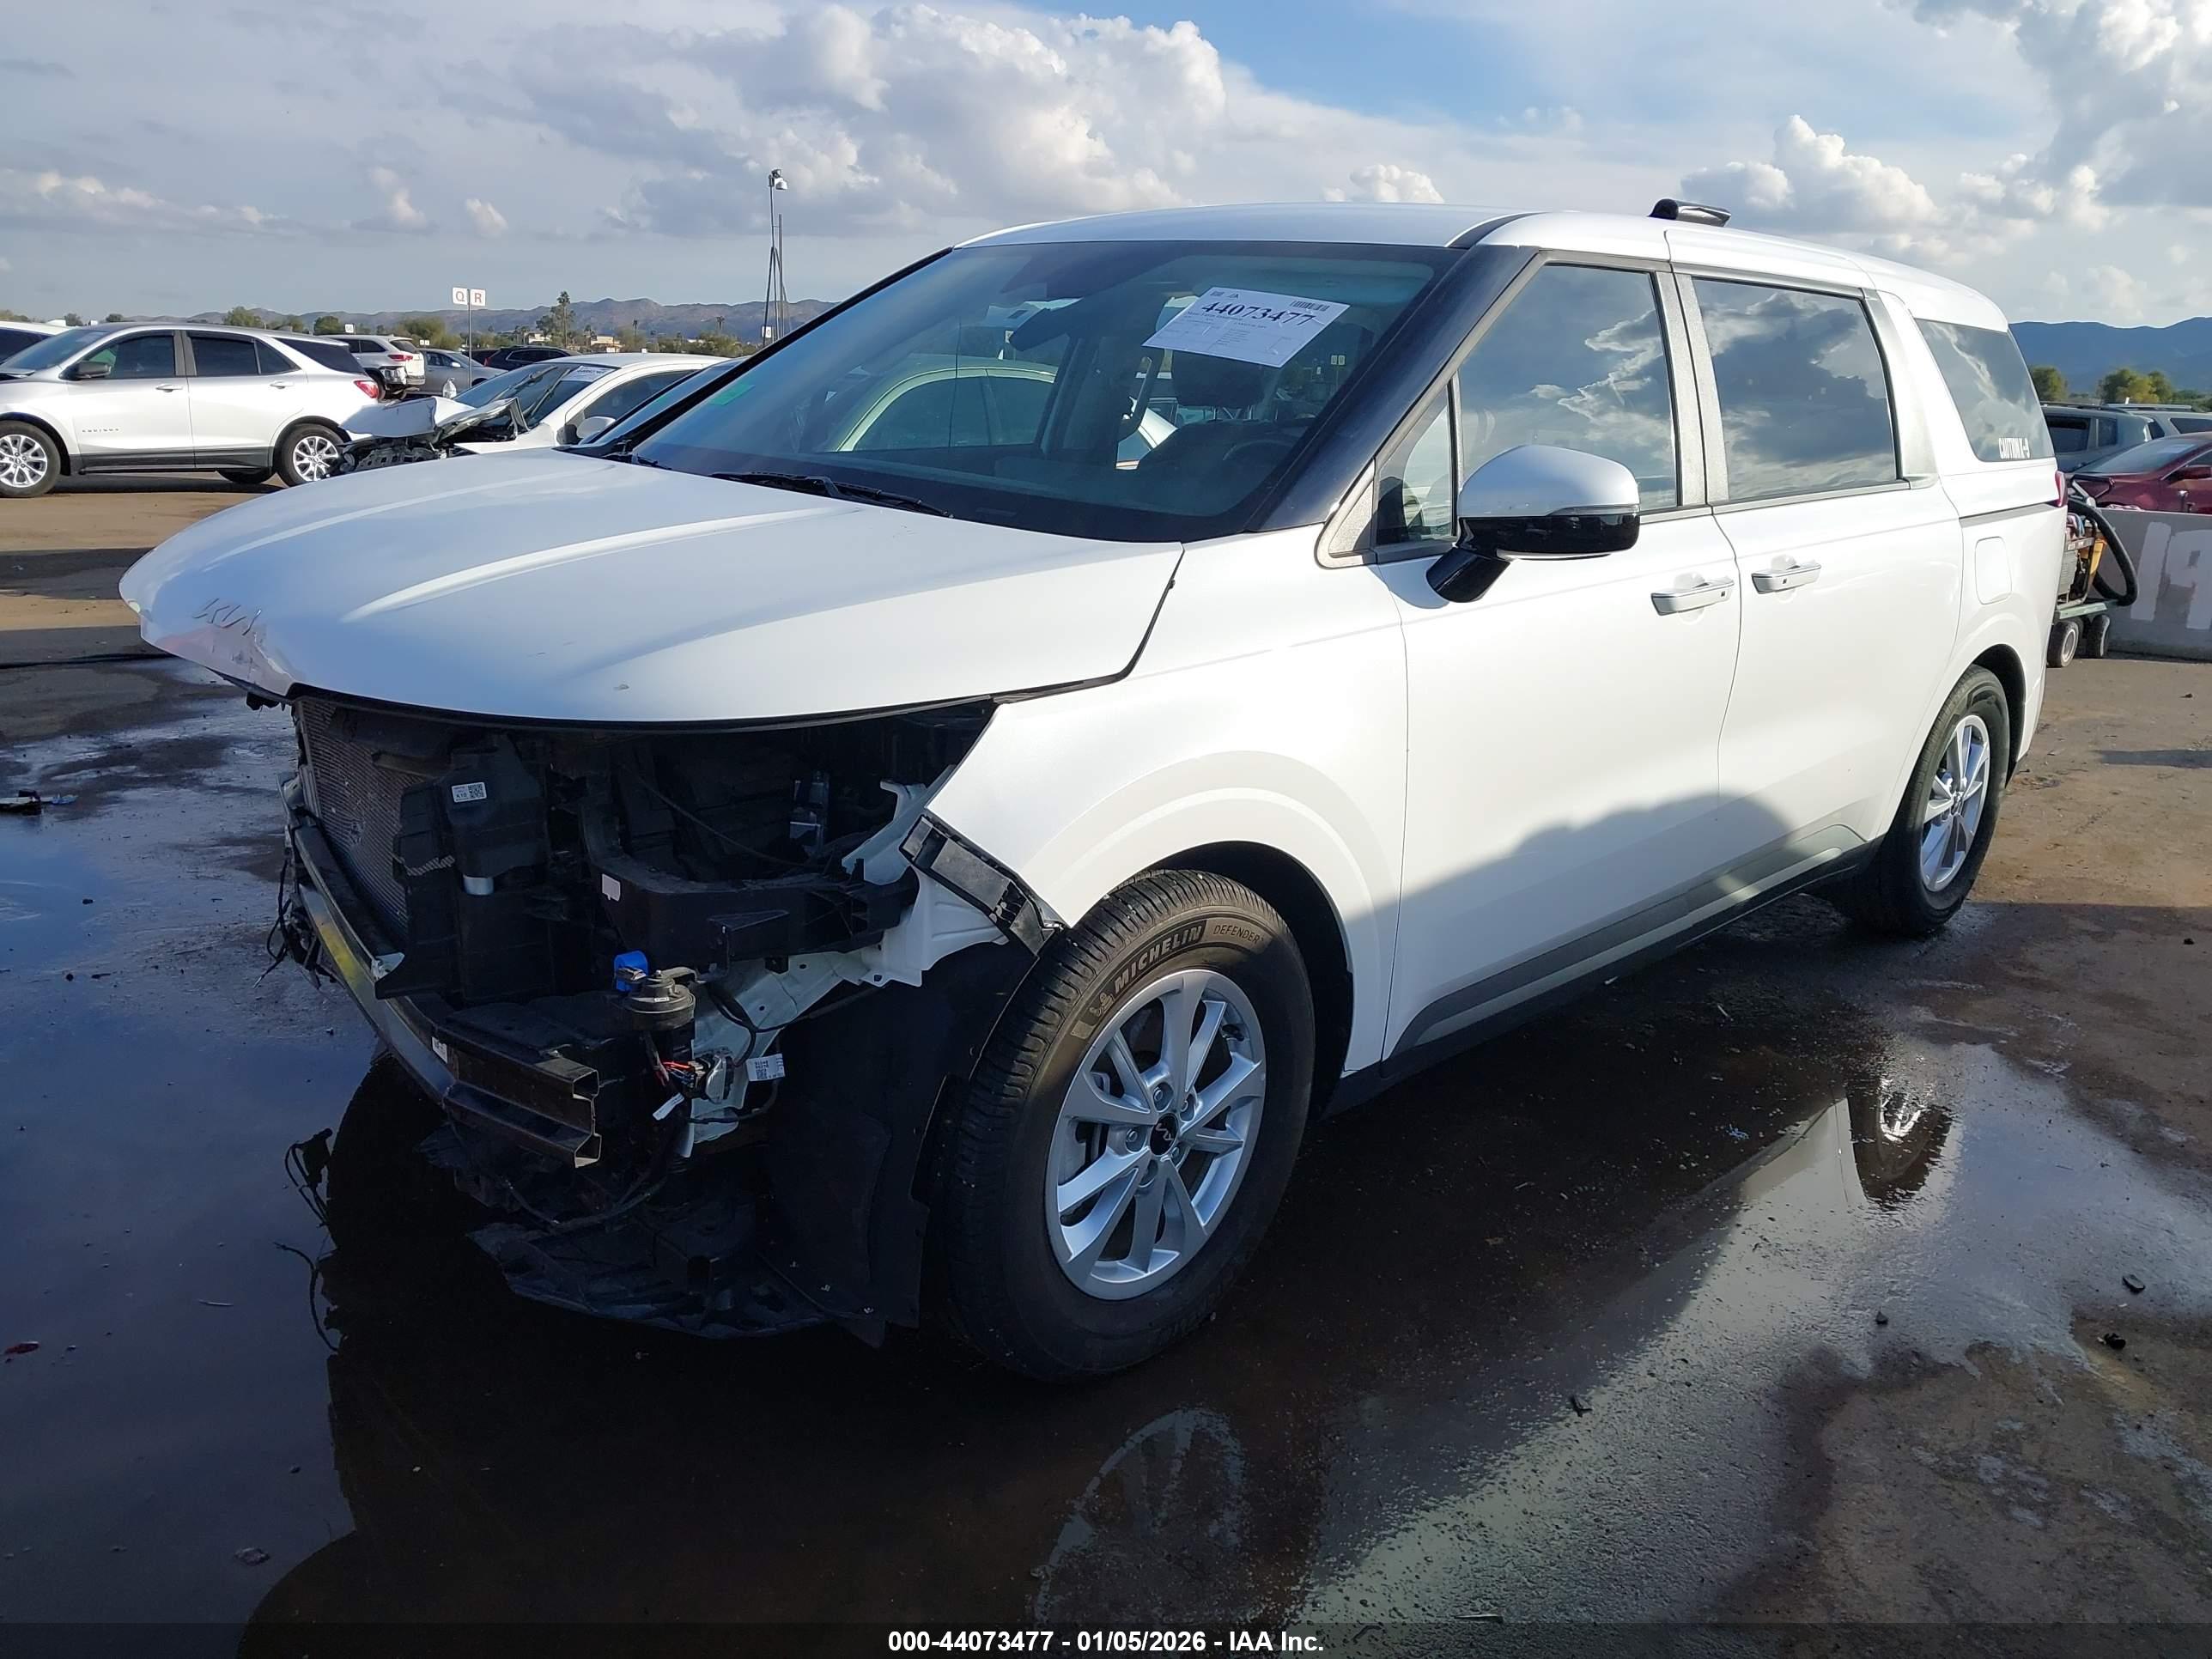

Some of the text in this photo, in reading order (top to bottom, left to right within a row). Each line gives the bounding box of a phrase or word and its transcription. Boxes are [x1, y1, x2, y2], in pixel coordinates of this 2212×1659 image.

[456, 291, 482, 303] Q R
[1202, 301, 1316, 325] 44073477
[1115, 925, 1261, 993] MICHELIN DEFENDER
